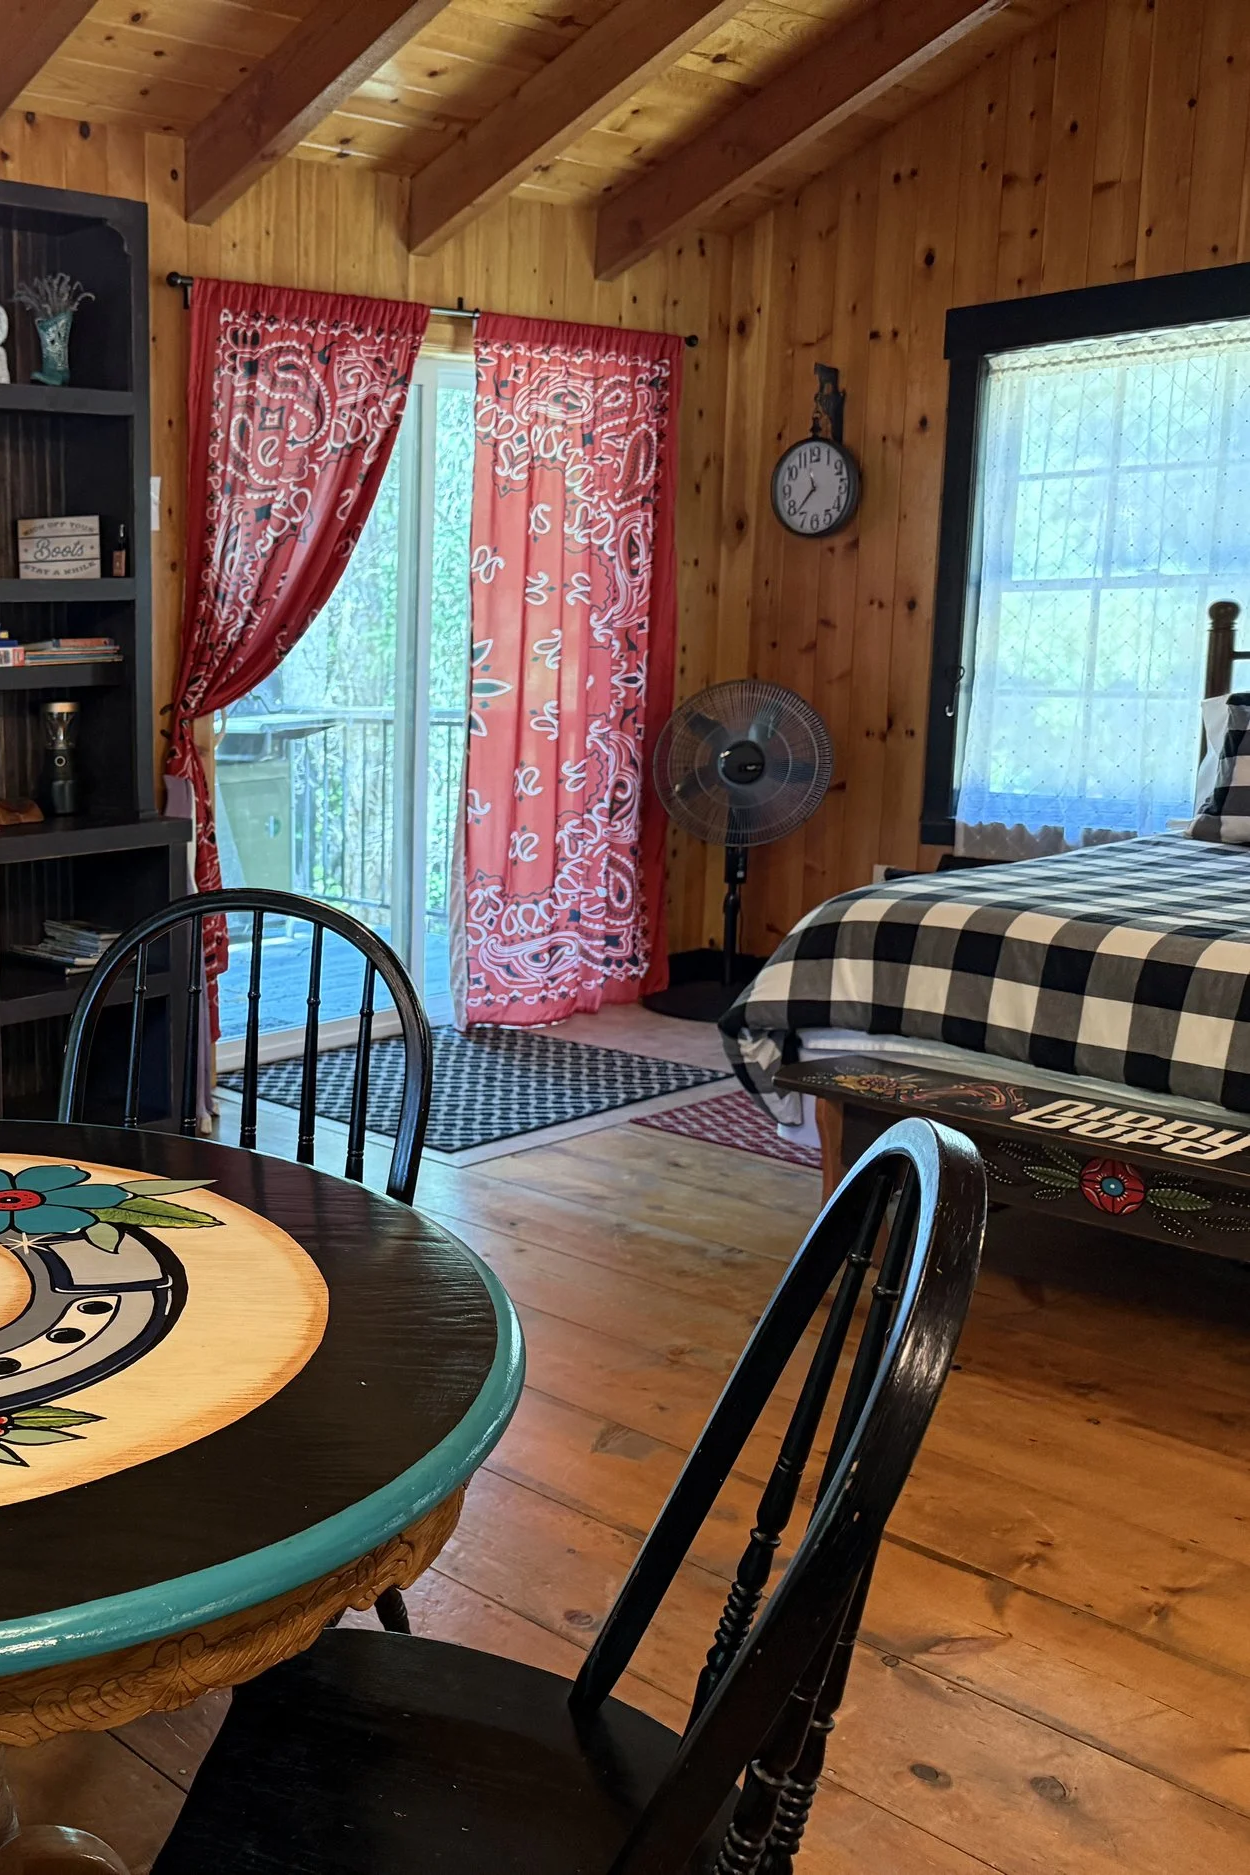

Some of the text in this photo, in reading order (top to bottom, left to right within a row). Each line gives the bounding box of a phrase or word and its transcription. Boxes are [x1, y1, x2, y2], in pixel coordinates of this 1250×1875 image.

[798, 451, 807, 468] 11
[809, 446, 821, 463] 12
[787, 465, 798, 481] 10
[834, 459, 843, 476] 2
[782, 484, 792, 500] 9
[838, 477, 848, 495] 3
[787, 500, 797, 516] 8
[832, 495, 841, 512] 4
[799, 511, 807, 528] 7
[810, 513, 820, 531] 6
[823, 508, 833, 526] 5
[34, 537, 84, 562] Boots
[23, 564, 51, 576] STAY
[64, 561, 96, 575] WHILE
